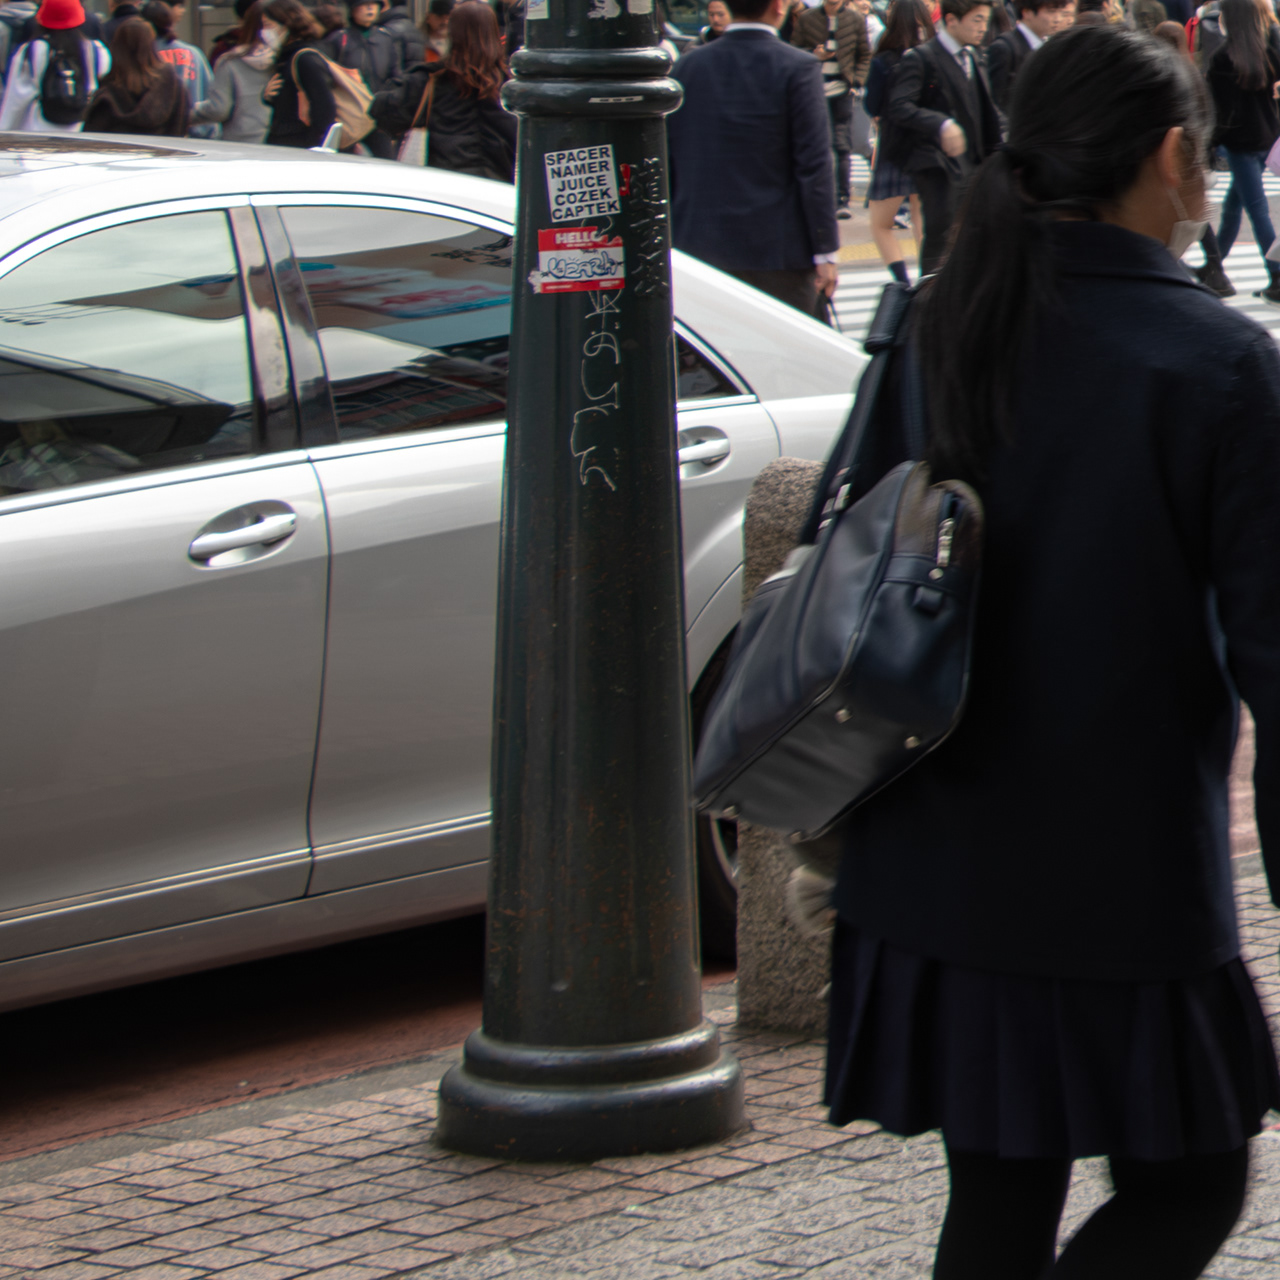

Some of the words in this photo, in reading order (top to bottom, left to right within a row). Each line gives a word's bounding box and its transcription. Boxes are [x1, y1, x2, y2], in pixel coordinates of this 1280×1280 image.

[546, 146, 611, 167] SPACER
[551, 160, 610, 180] NAMER
[556, 174, 608, 193] JUICE
[554, 187, 612, 207] COZEK
[552, 200, 620, 220] CAPTEK
